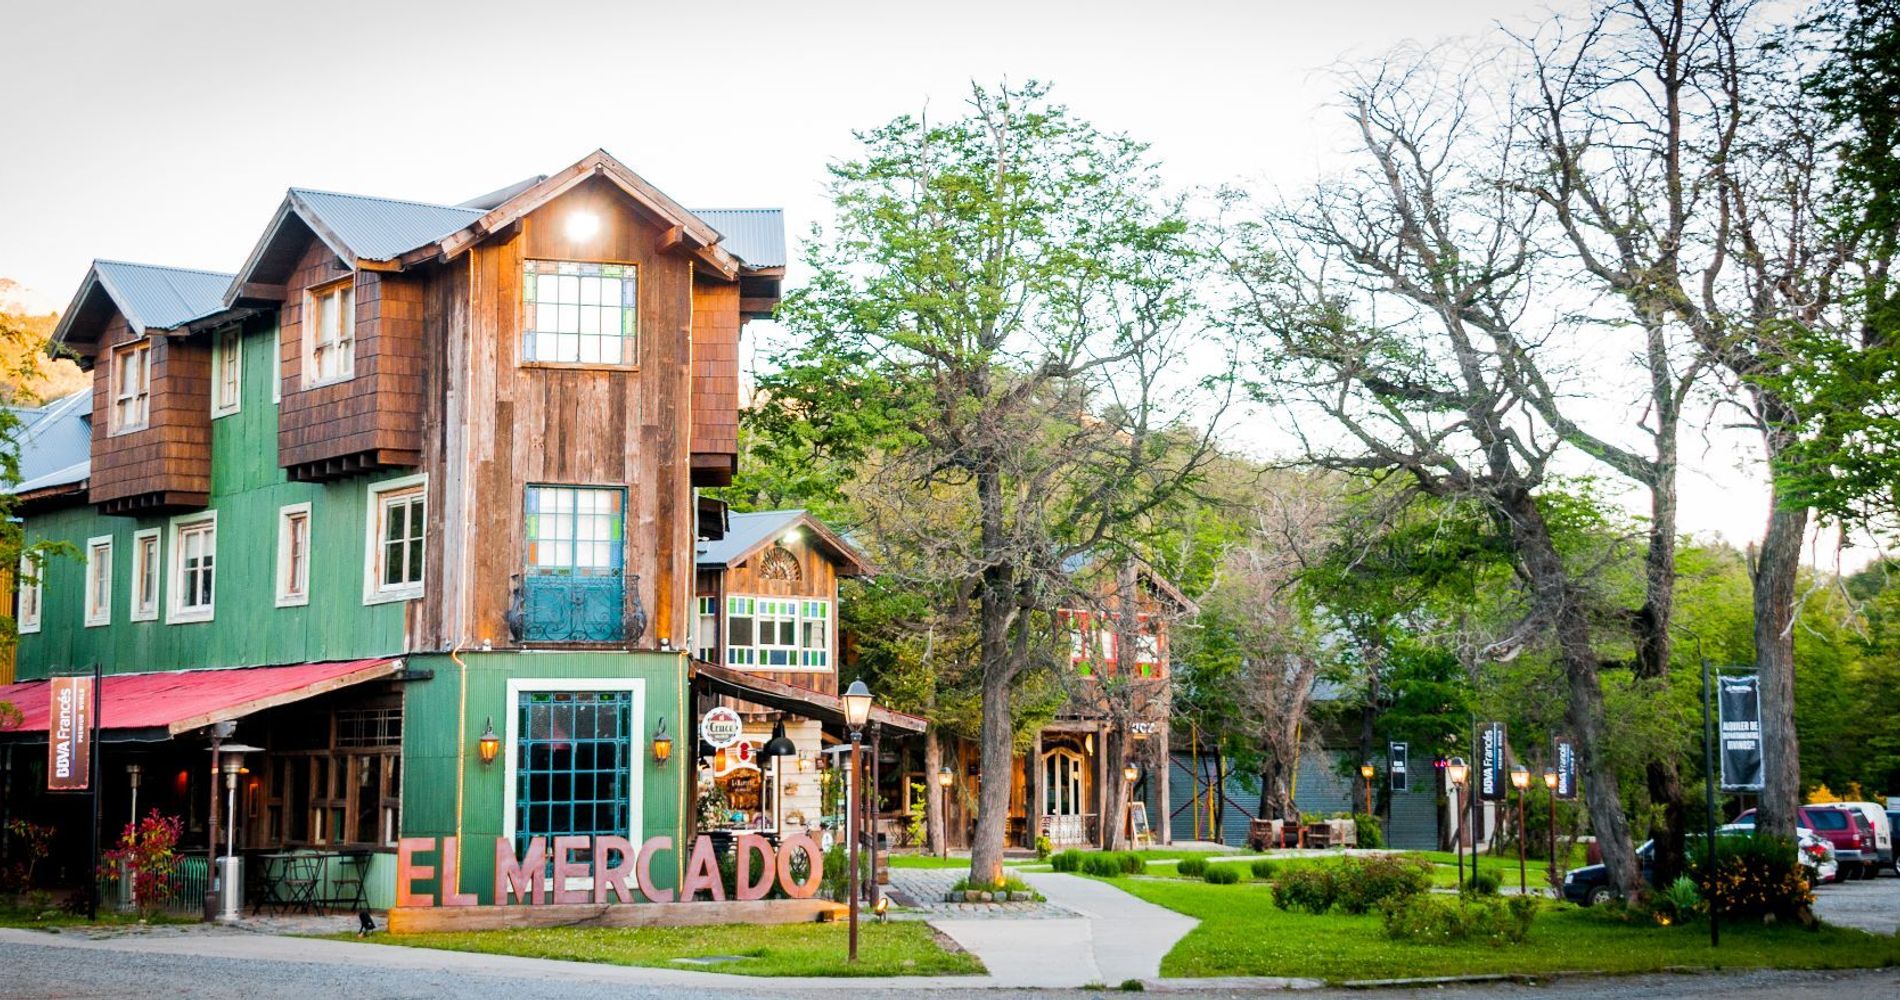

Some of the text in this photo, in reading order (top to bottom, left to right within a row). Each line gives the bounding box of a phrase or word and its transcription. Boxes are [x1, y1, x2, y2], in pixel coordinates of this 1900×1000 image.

[56, 687, 71, 778] BBVA Francés
[1482, 730, 1494, 794] BBVA Francés
[396, 832, 825, 907] EL MERCADO
